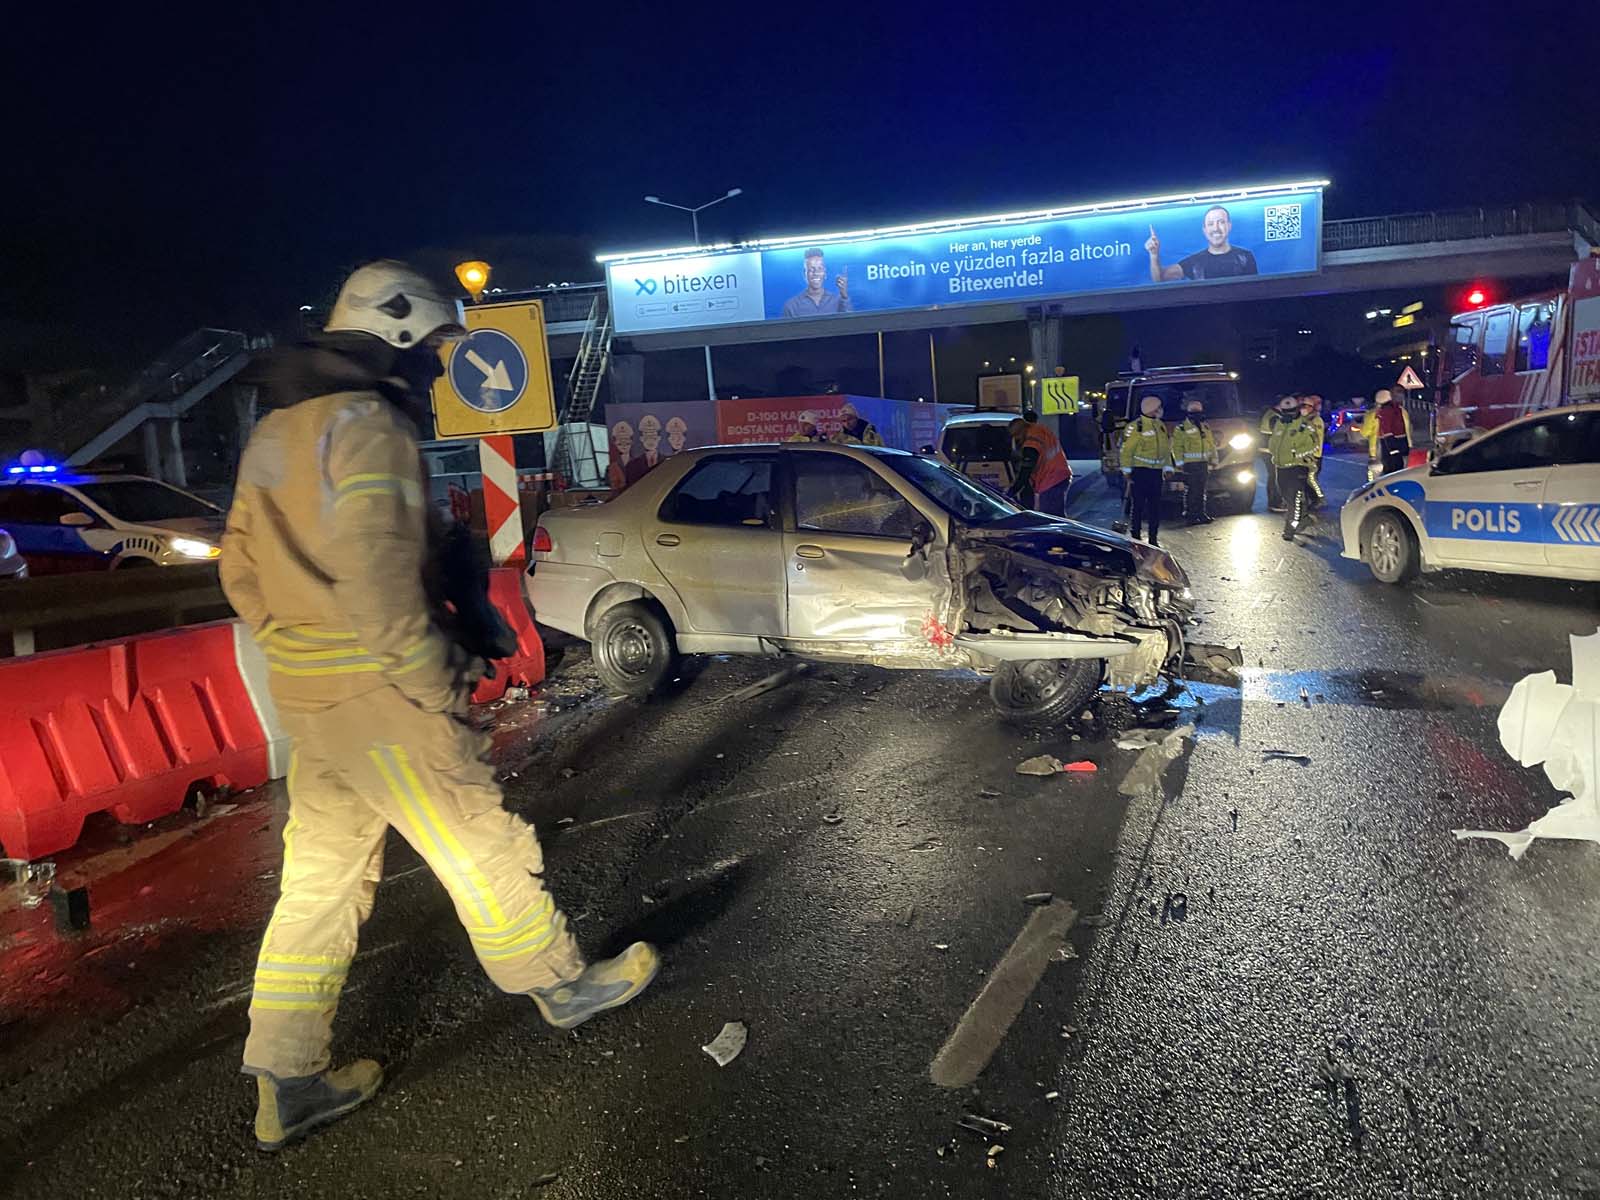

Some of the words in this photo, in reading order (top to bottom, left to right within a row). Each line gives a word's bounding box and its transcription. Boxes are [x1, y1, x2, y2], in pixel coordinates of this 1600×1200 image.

[949, 241, 969, 254] Her
[971, 240, 988, 252] an,
[990, 237, 1008, 250] her
[1009, 234, 1042, 249] yerde
[866, 260, 926, 281] Bitcoin
[930, 261, 950, 275] ve
[954, 252, 1016, 279] yüzden
[1020, 246, 1064, 266] fazla
[1069, 240, 1131, 261] altcoin
[663, 273, 738, 295] bitexen
[949, 269, 1044, 294] Bitexen'de!
[1452, 505, 1521, 534] POLİS
